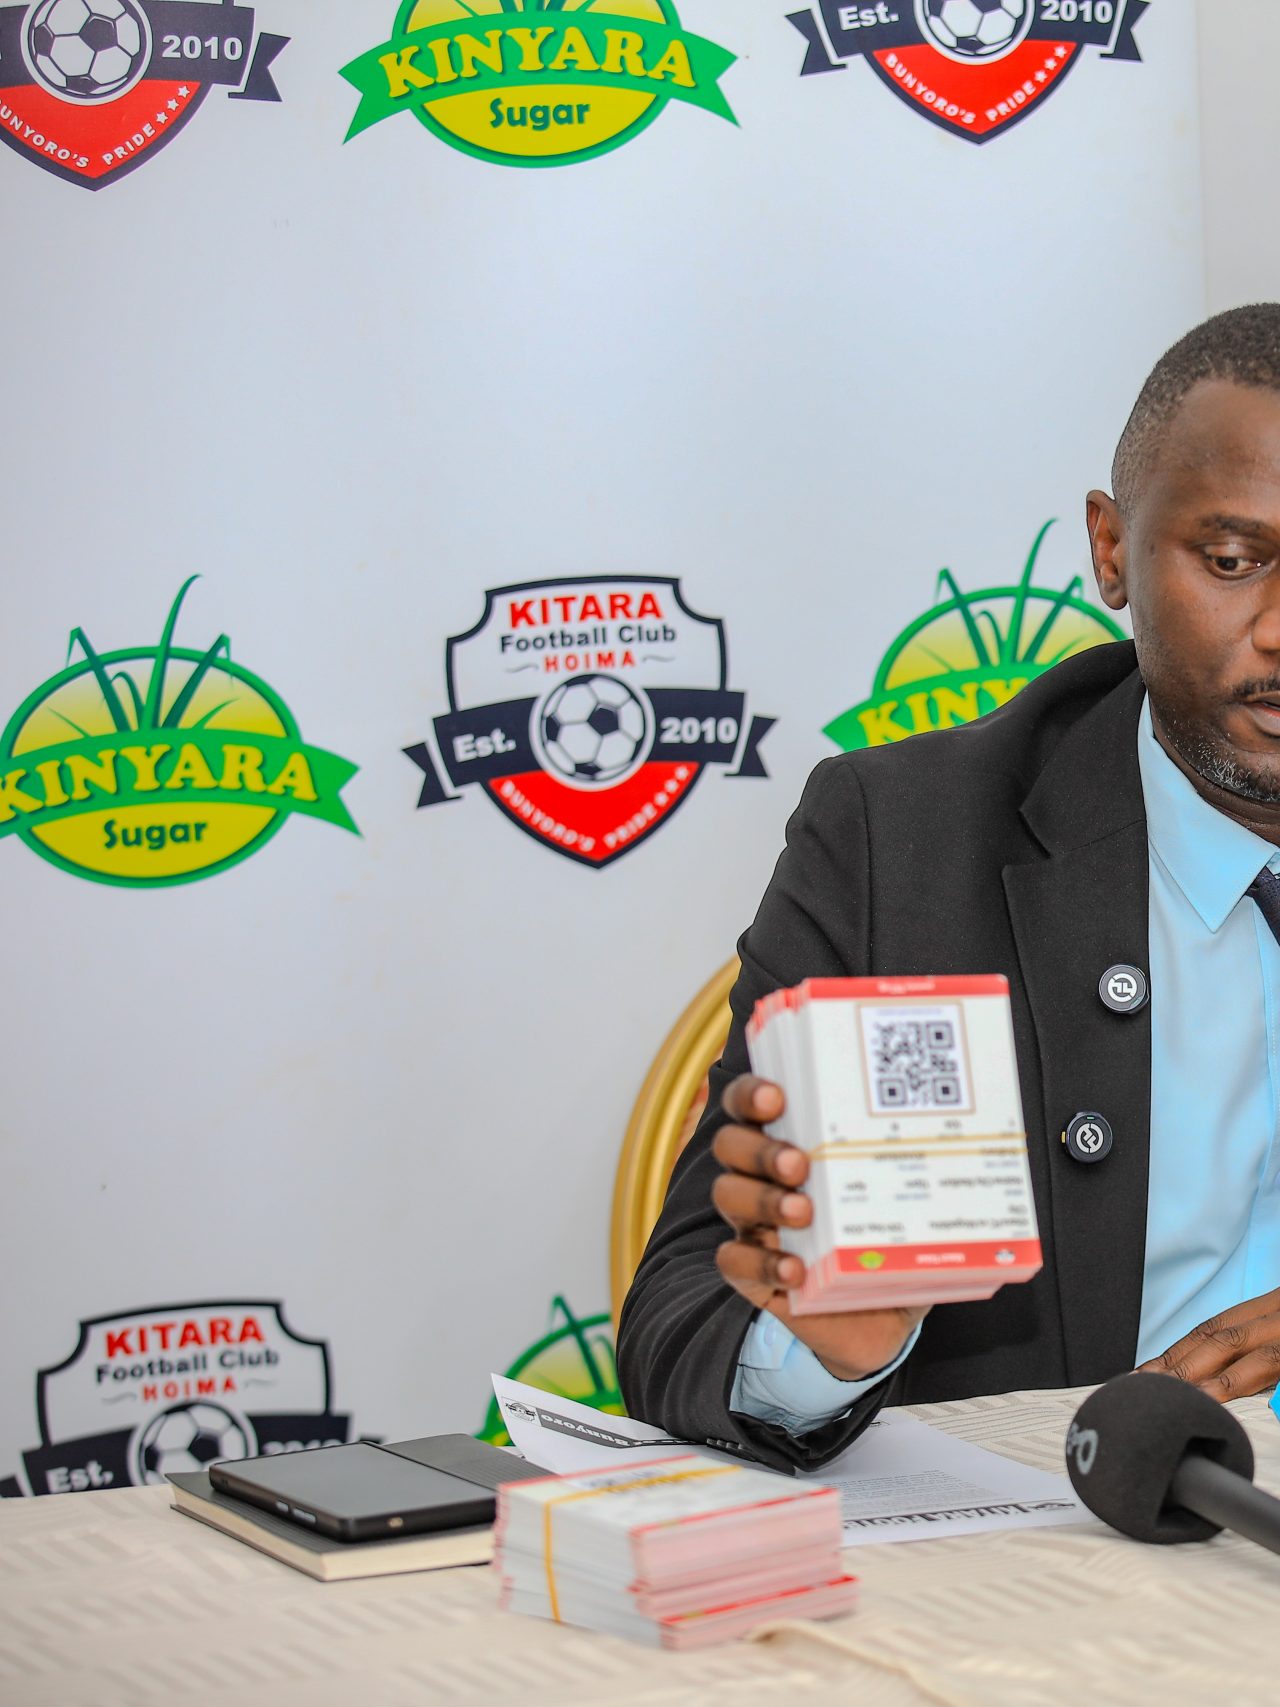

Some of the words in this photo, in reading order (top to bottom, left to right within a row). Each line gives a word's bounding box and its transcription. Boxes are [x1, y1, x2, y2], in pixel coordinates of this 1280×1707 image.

[837, 1, 900, 31] Est.
[1039, 0, 1113, 24] 2010
[161, 34, 244, 62] 2010
[378, 26, 697, 98] KINYARA
[884, 52, 977, 125] BUNYORO'S
[984, 80, 1037, 123] PRIDE
[489, 97, 591, 131] Sugar
[0, 102, 90, 169] UNYORO'S
[101, 122, 156, 167] PRIDE
[509, 592, 663, 629] KITARA
[500, 626, 608, 653] Football
[618, 624, 677, 644] Club
[545, 650, 637, 673] HOIMA
[856, 677, 1030, 748] KINY
[452, 728, 517, 764] Est.
[659, 716, 739, 745] 2010
[500, 780, 596, 853] BUNYORO'S
[604, 802, 658, 850] PRIDE
[103, 818, 208, 851] Sugar
[104, 1316, 266, 1360] KITARA
[95, 1352, 208, 1385] Football
[218, 1348, 280, 1369] Club
[142, 1375, 238, 1402] HOIMA
